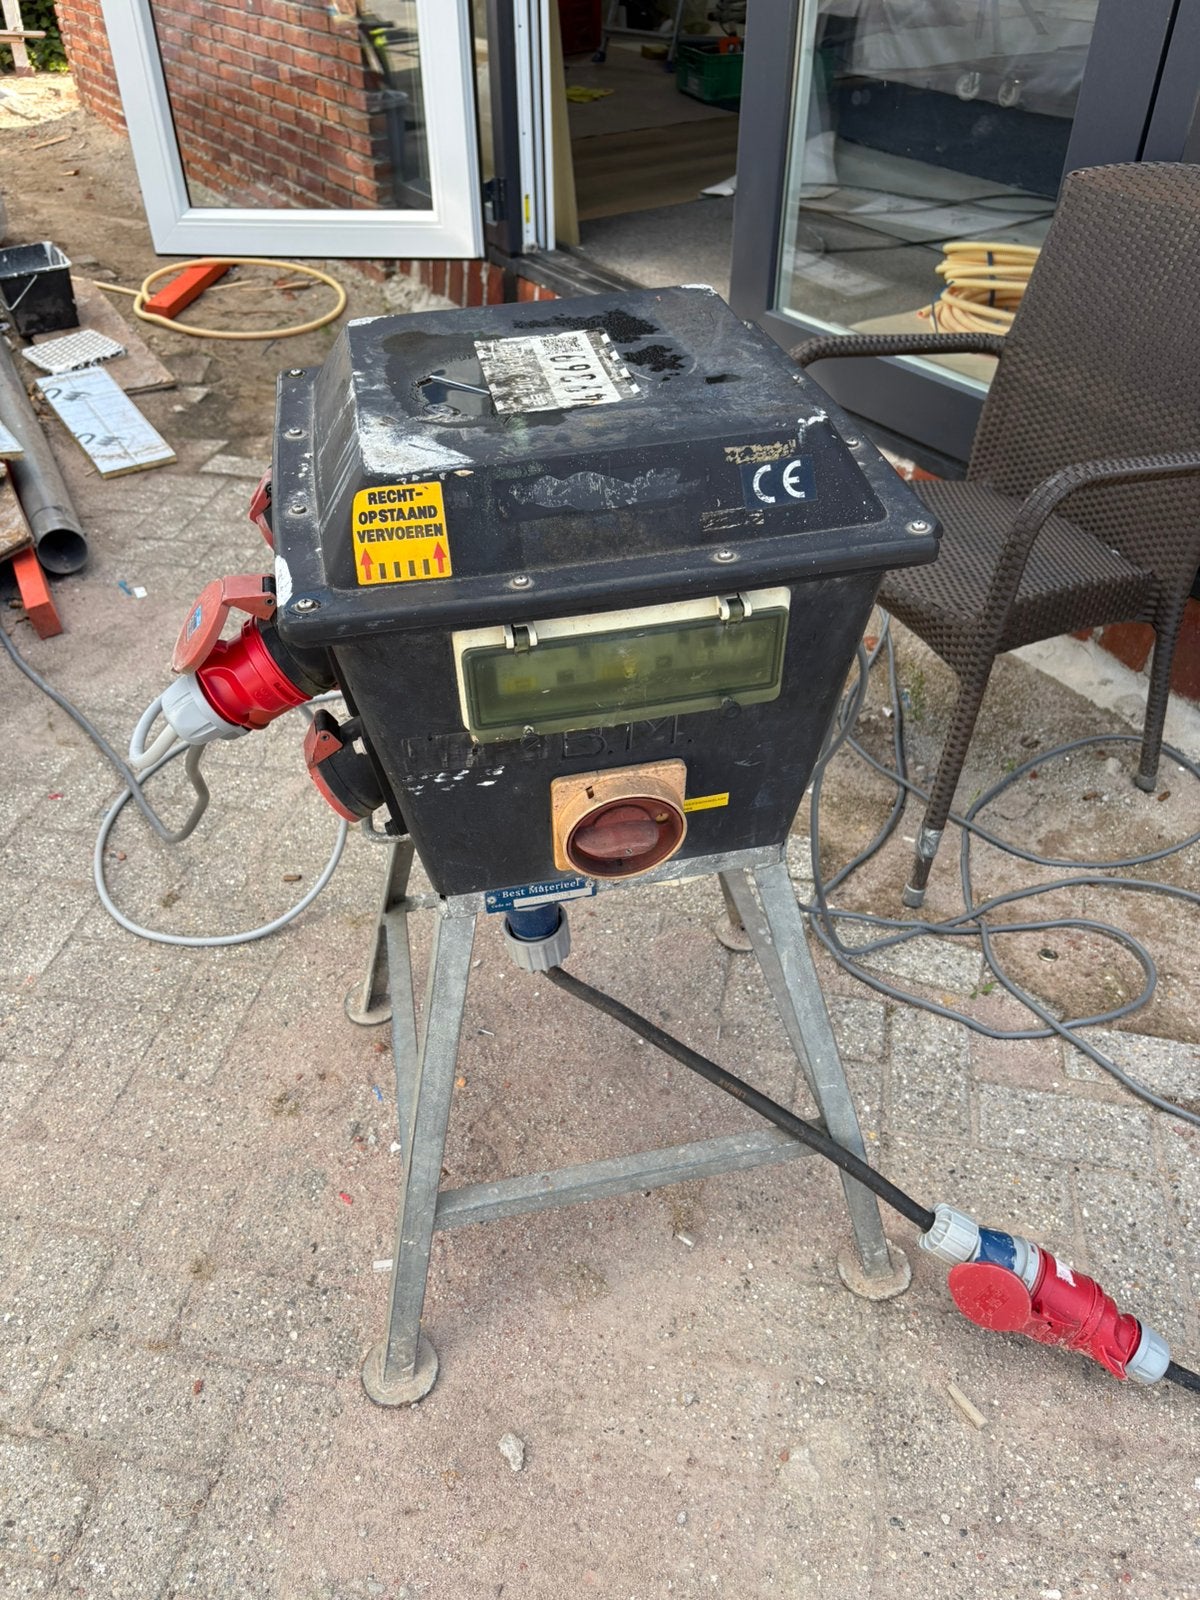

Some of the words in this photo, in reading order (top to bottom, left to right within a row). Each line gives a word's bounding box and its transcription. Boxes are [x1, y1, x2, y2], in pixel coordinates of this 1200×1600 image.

[752, 460, 805, 503] CE
[367, 488, 423, 505] RECHT-
[358, 505, 438, 525] OPSTAAND
[357, 523, 444, 543] VERVOEREN
[502, 889, 525, 898] Best
